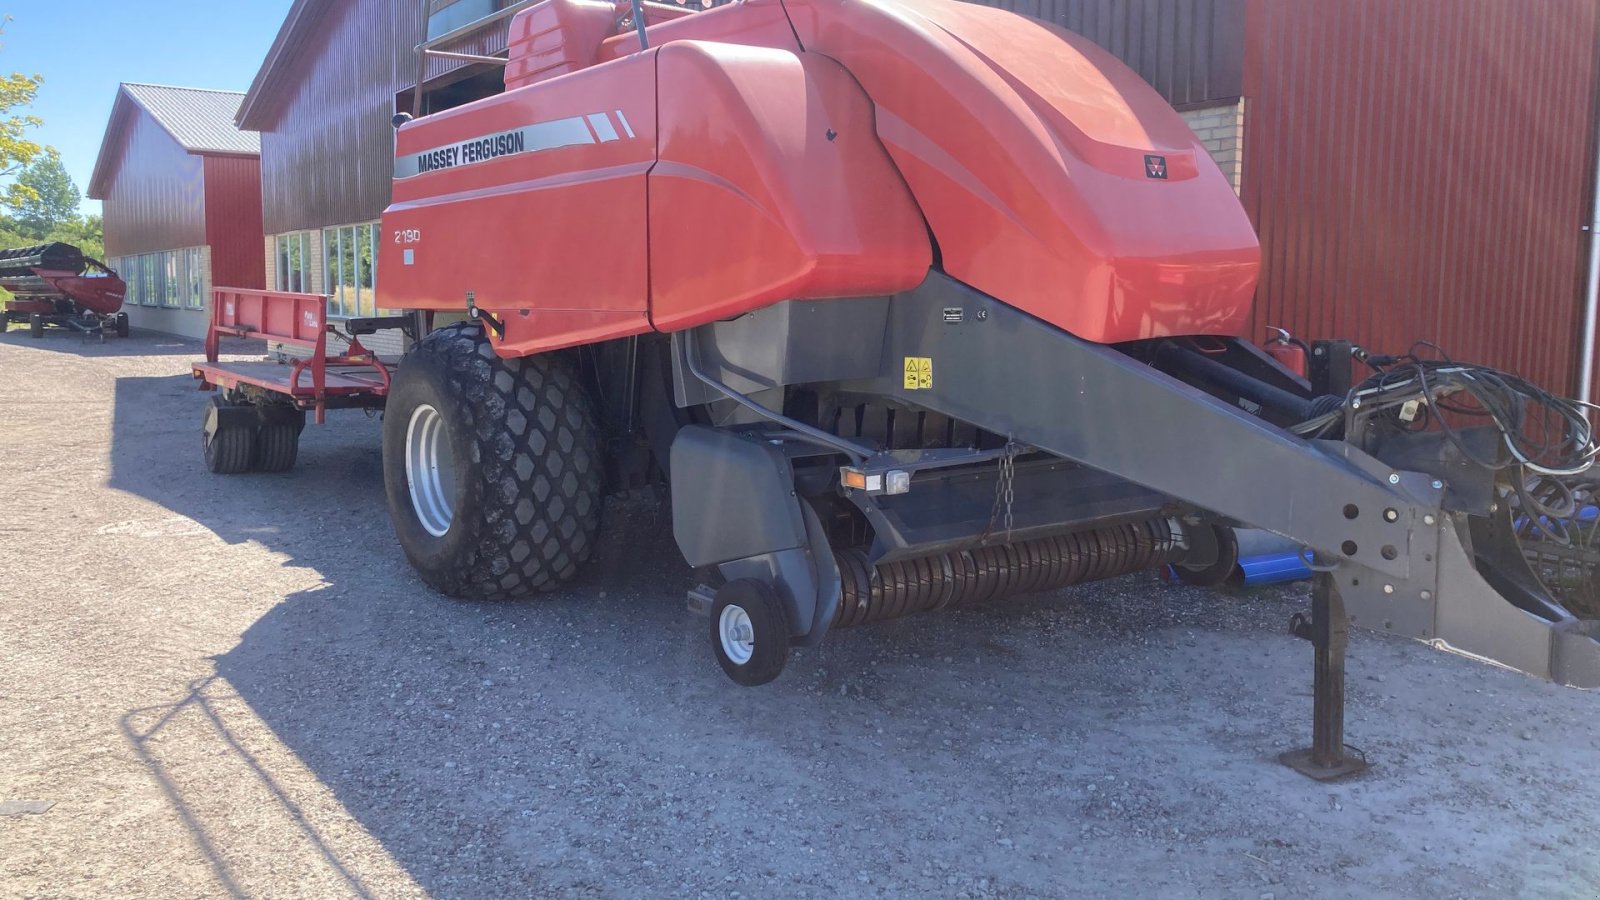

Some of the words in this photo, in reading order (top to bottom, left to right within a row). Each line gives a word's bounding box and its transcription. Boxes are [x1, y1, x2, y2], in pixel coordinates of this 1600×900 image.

[418, 146, 459, 173] MASSEY
[462, 131, 524, 164] FERGUSON
[394, 229, 420, 243] 2190
